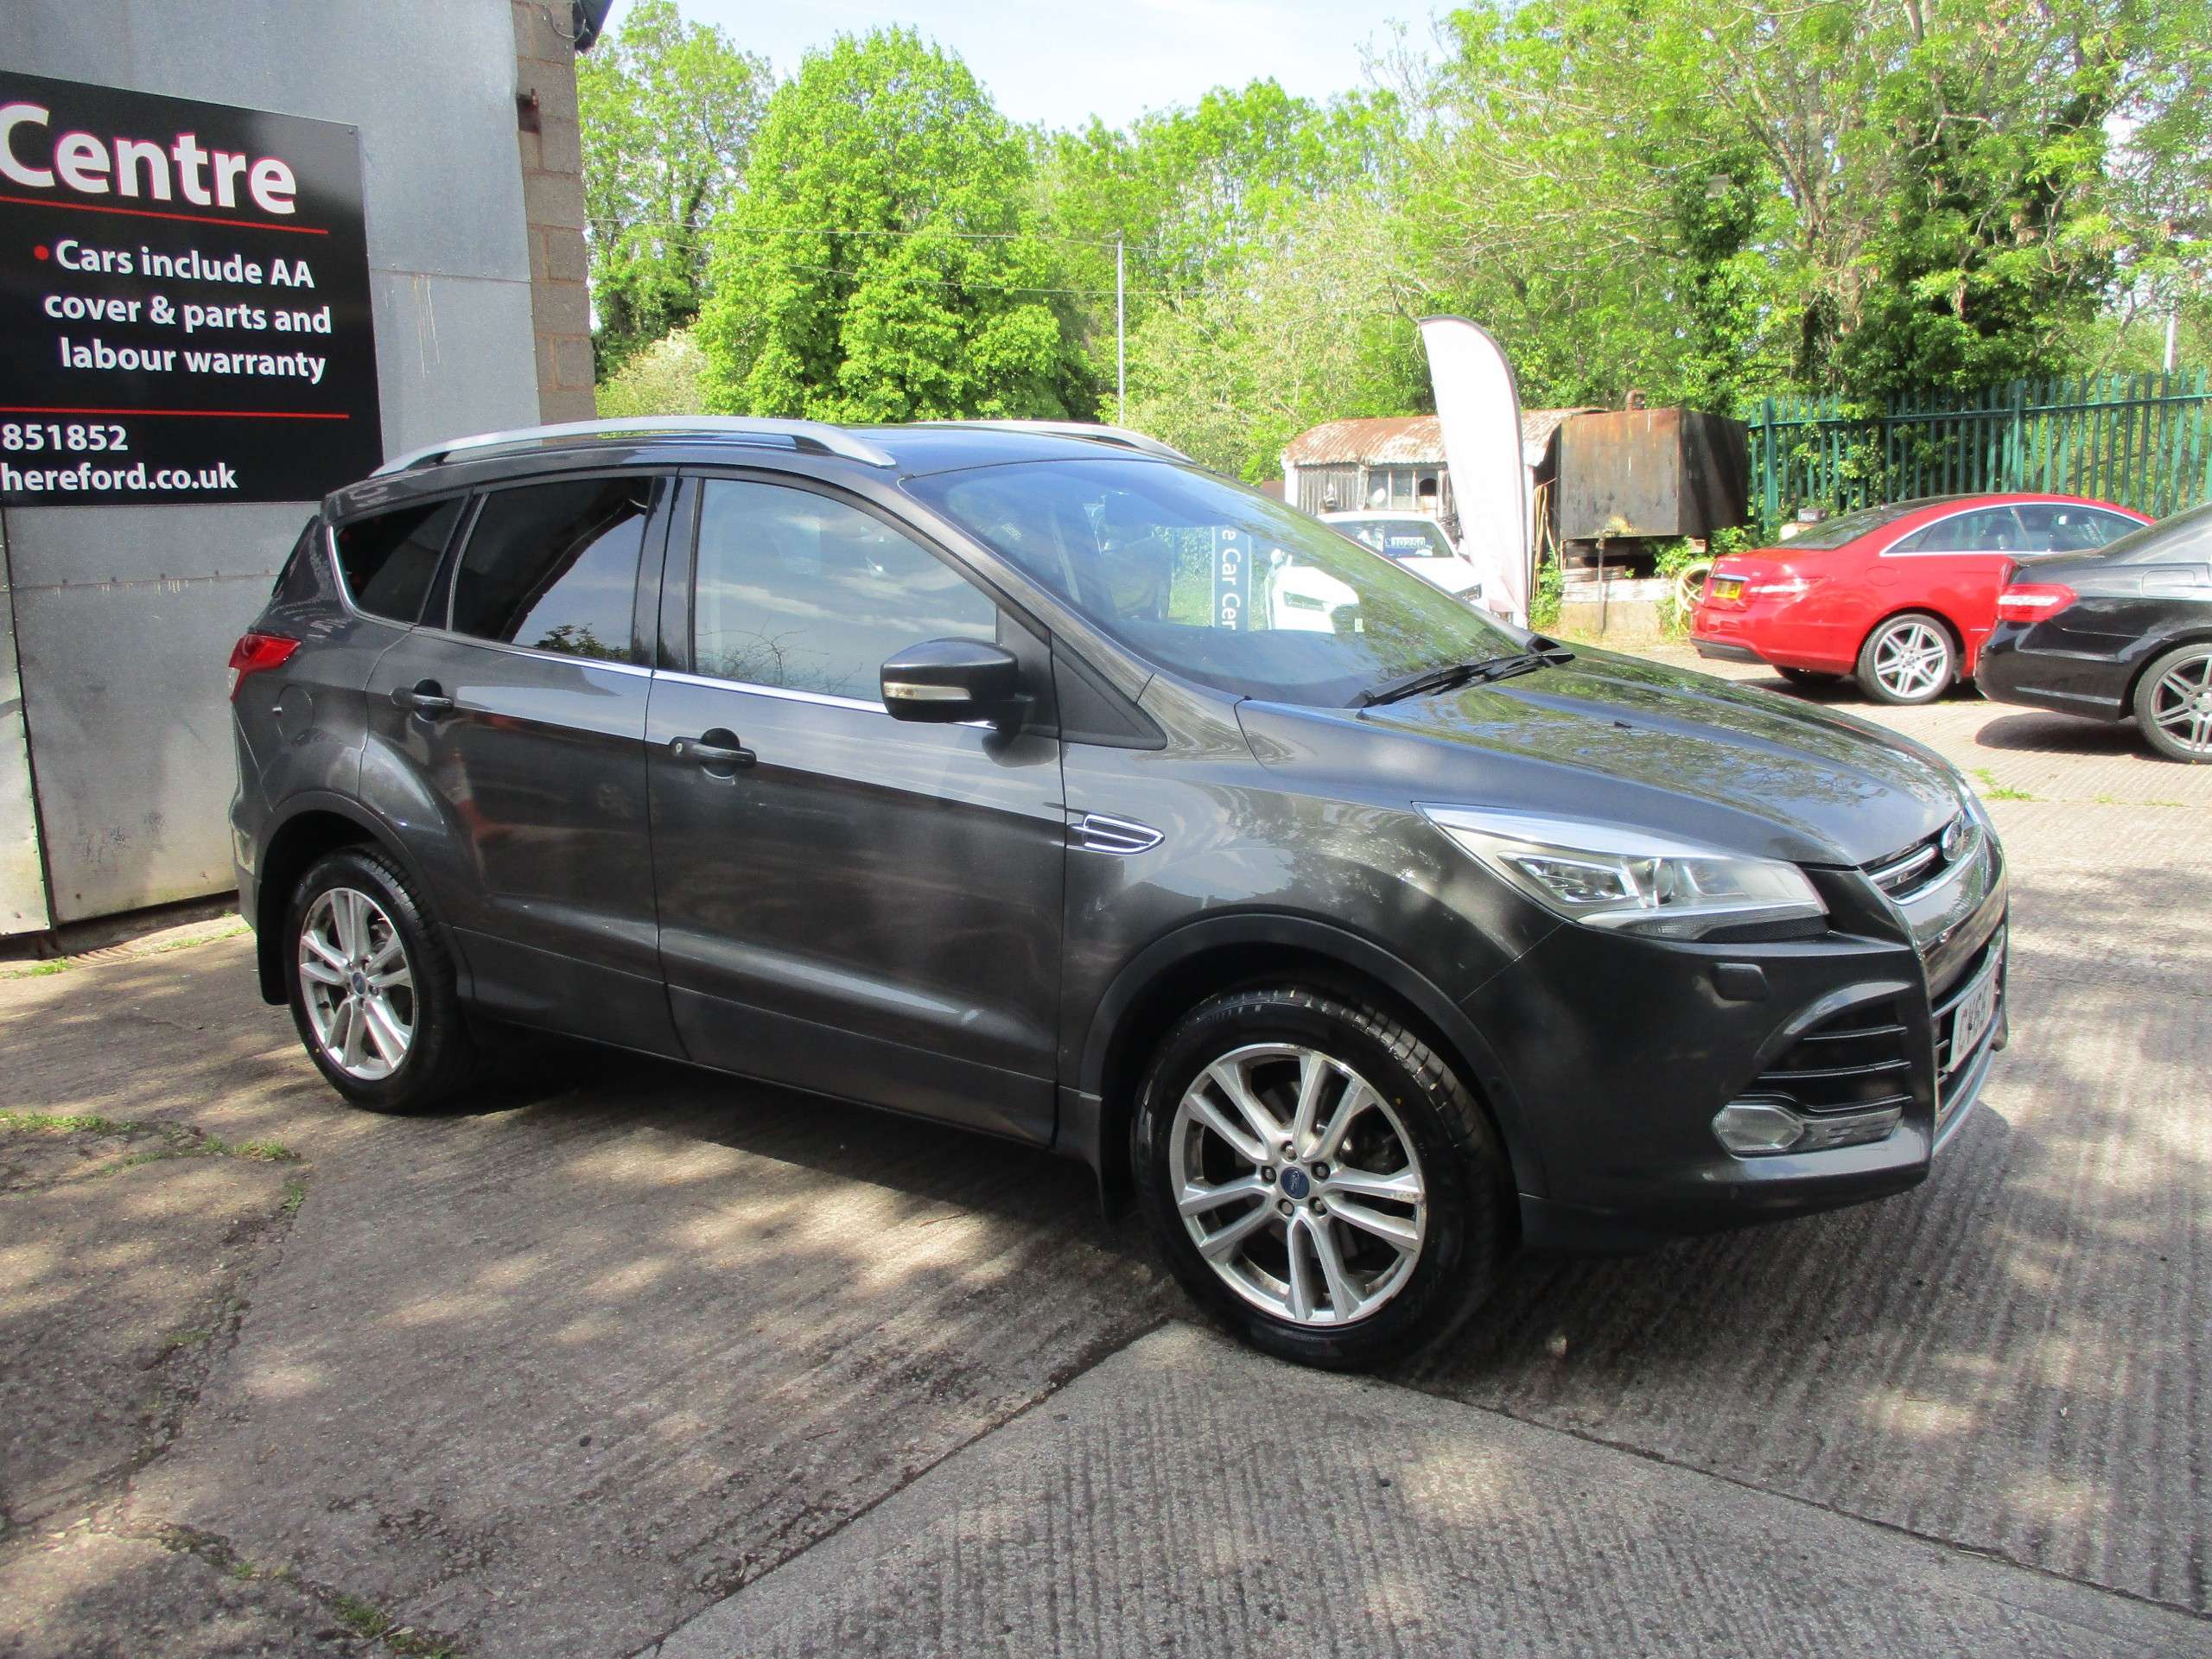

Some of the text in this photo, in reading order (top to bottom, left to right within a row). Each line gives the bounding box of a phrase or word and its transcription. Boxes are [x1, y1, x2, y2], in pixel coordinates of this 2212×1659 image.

[0, 104, 297, 214] Centre
[55, 239, 315, 289] Cars include AA
[44, 295, 332, 334] cover & parts and
[60, 336, 327, 385] labour warranty
[2, 423, 129, 451] 851852
[0, 462, 238, 491] hereford.co.uk
[1222, 548, 1241, 586] Car
